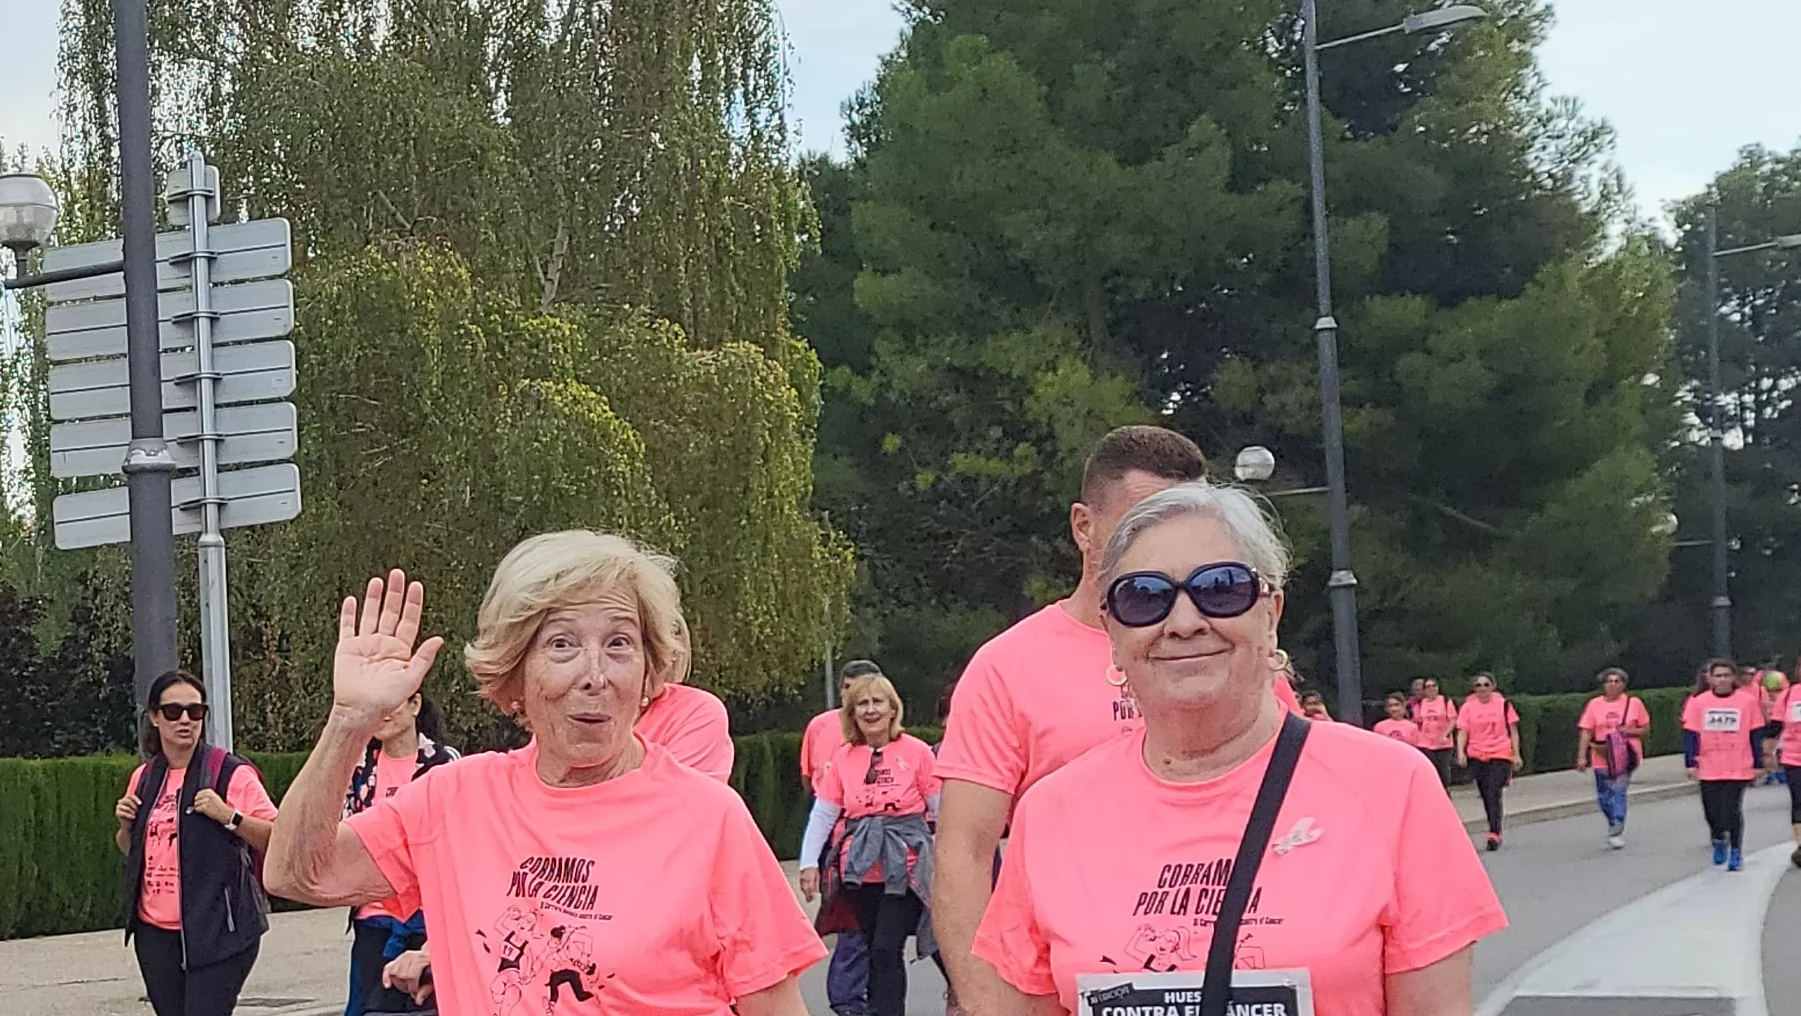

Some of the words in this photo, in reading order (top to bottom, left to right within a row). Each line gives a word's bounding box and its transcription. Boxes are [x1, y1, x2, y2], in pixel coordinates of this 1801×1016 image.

[520, 856, 595, 884] CORRAMOS
[1157, 858, 1232, 888] CORRAM
[543, 884, 599, 910] CIENCIA
[1132, 891, 1170, 916] POR
[1170, 887, 1191, 916] LA
[1195, 887, 1262, 915] CIEA
[1164, 991, 1202, 1003] HUES
